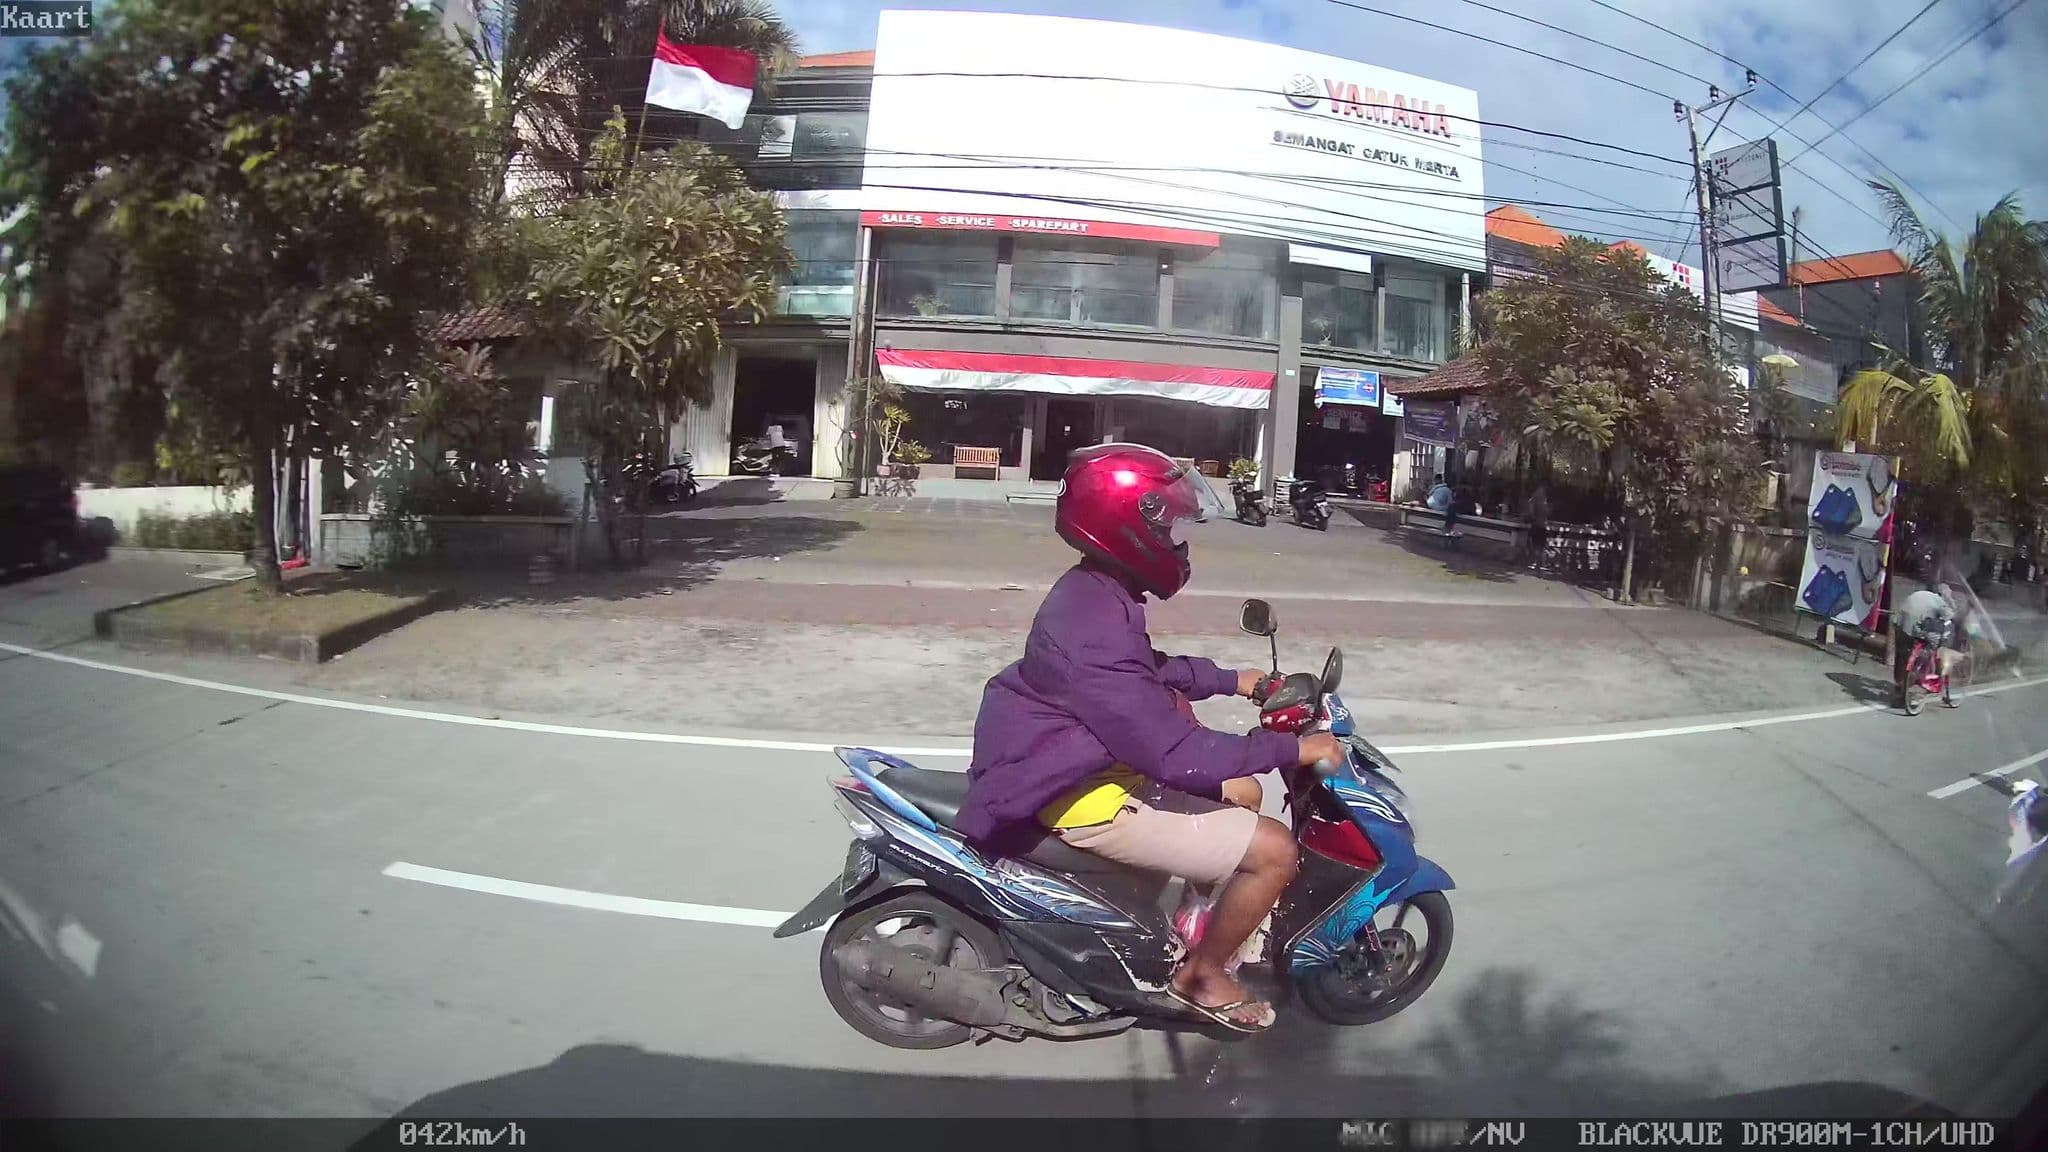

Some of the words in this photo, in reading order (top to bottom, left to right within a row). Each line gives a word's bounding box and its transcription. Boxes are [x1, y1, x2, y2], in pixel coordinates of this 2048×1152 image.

[1324, 79, 1451, 138] YAMAHA
[1273, 130, 1355, 155] SEMANGAT
[1362, 148, 1408, 167] CATUR
